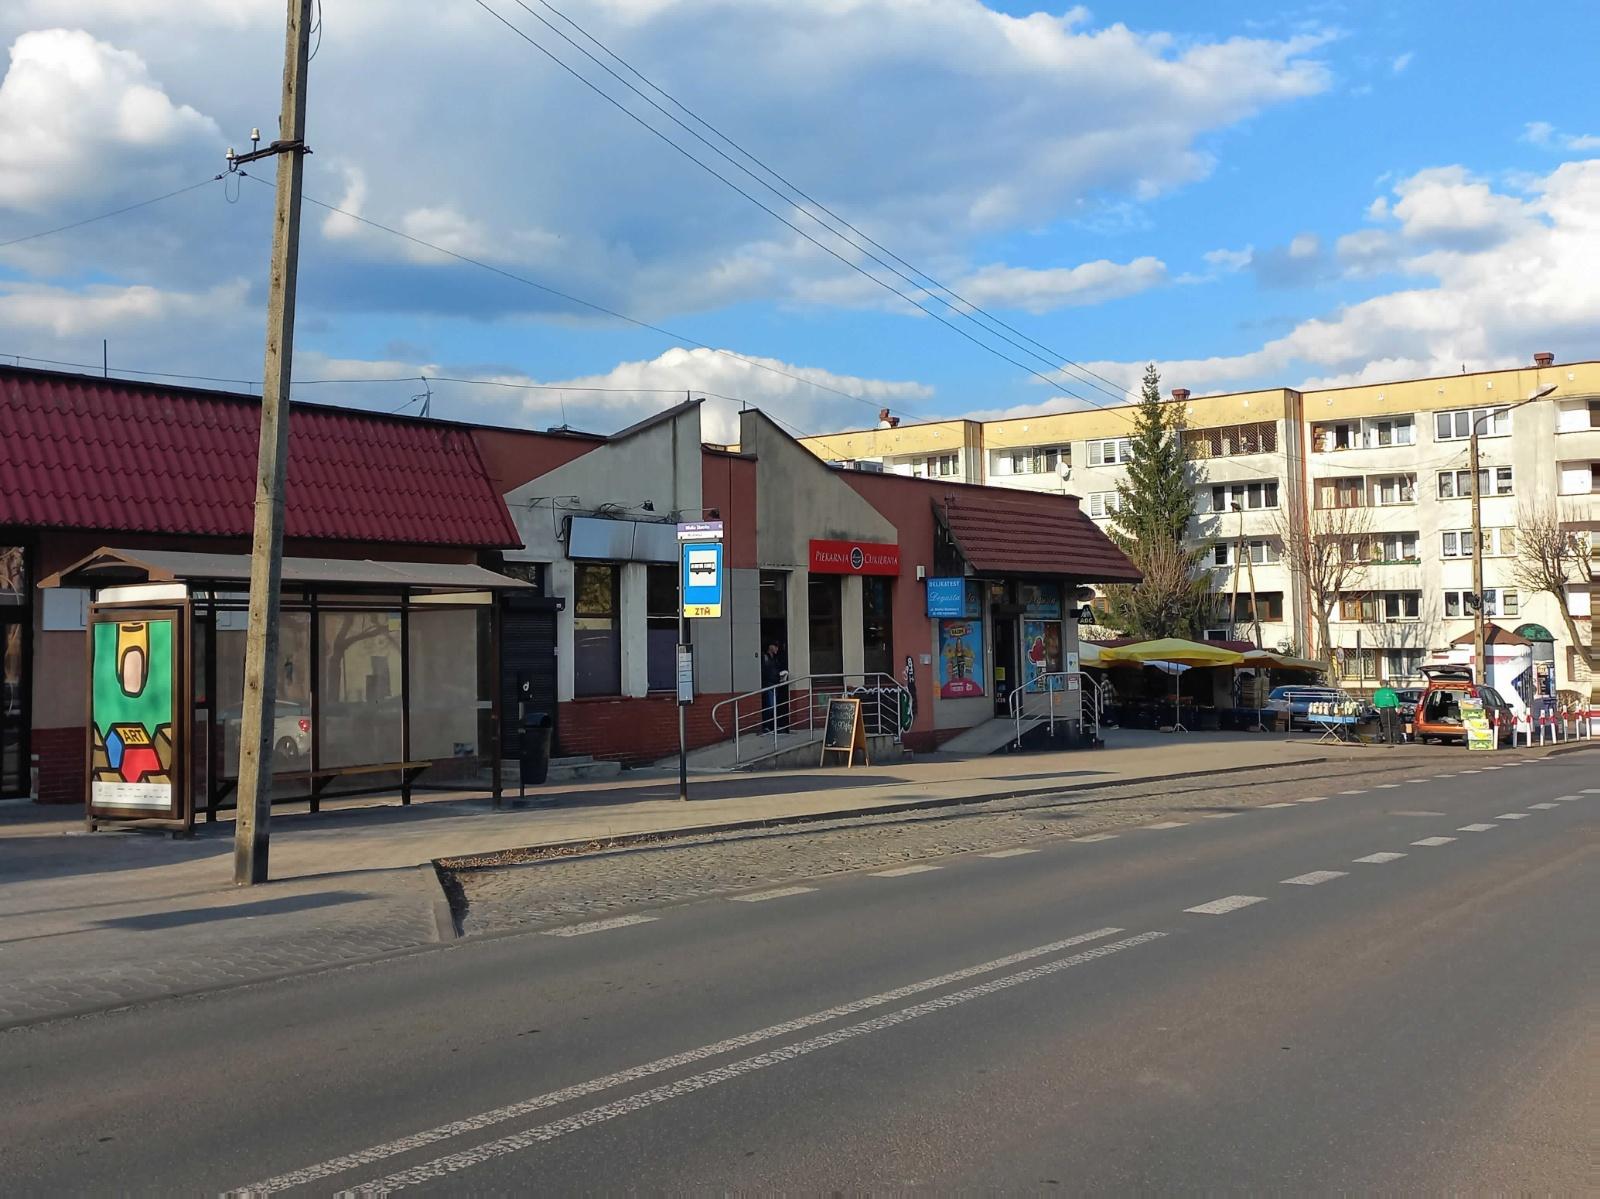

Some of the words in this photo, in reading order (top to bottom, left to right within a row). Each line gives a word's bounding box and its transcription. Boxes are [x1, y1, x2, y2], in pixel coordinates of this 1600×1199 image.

[815, 550, 849, 563] PIEKARNIA
[864, 553, 898, 565] CUKIERNIA
[122, 729, 145, 743] ART
